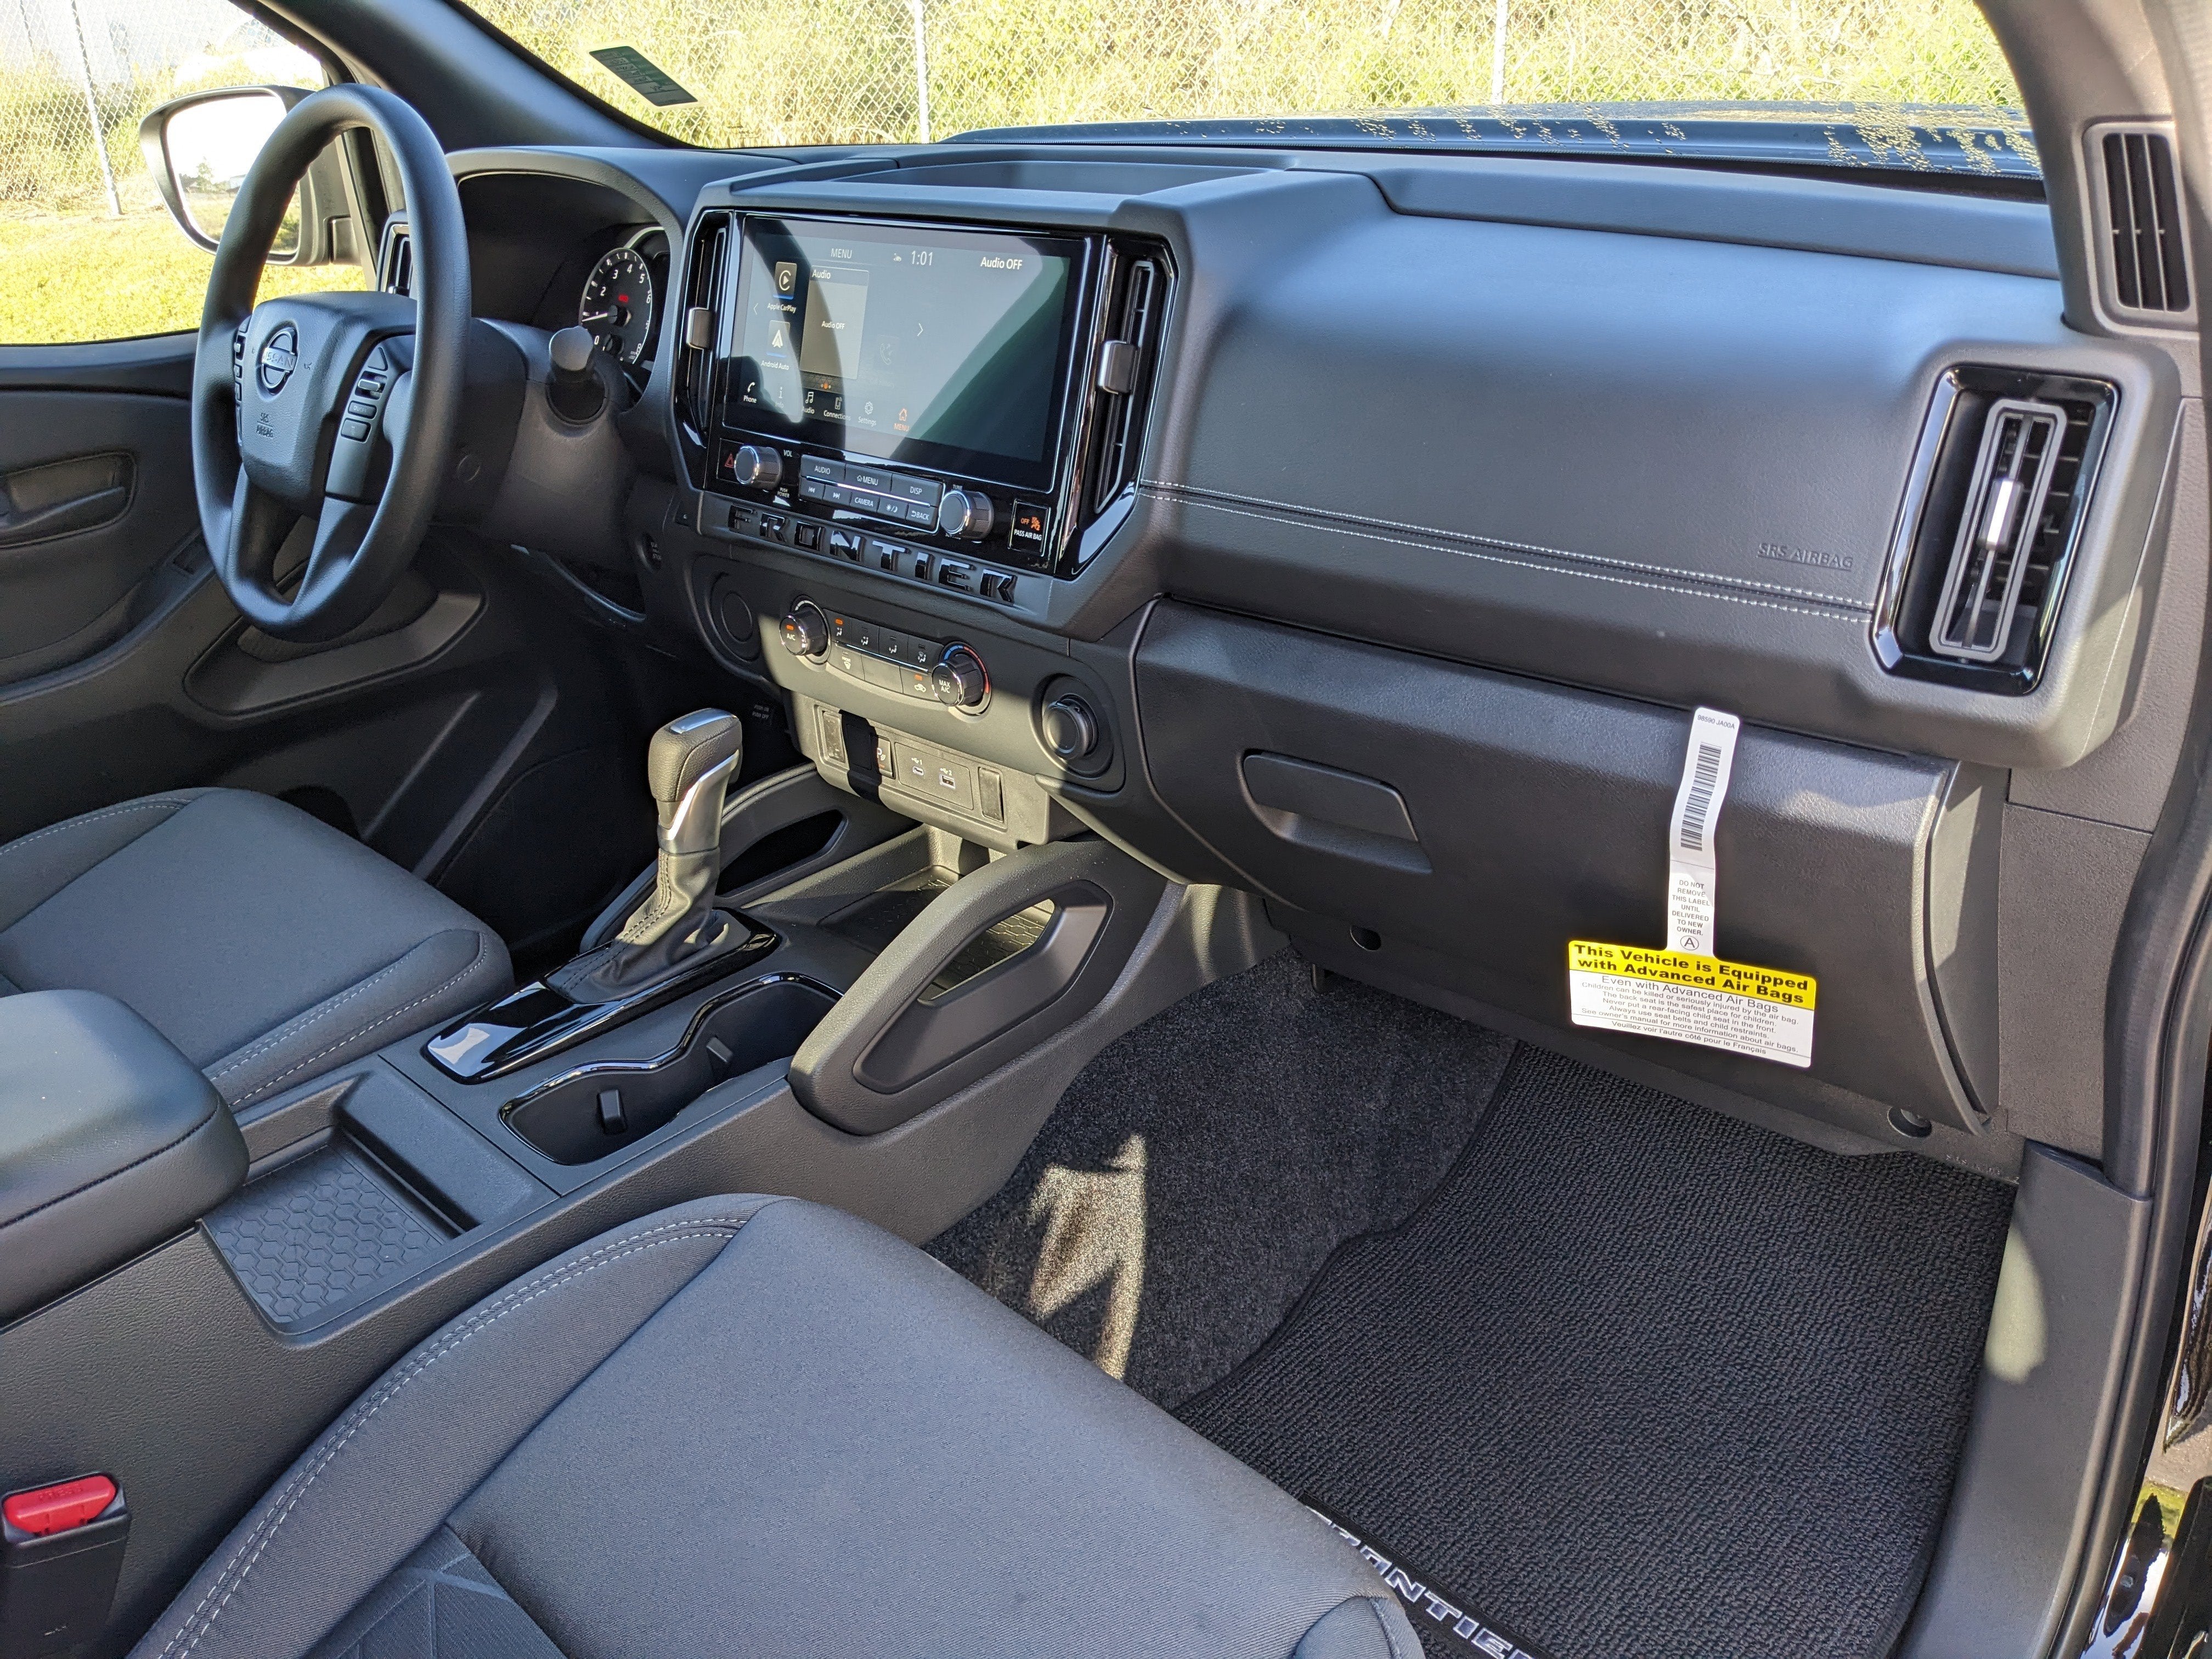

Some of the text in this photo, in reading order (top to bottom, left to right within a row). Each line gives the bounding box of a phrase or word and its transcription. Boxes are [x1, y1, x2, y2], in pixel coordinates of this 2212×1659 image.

[831, 248, 852, 259] MENU
[911, 250, 933, 266] 1:01
[980, 257, 1023, 270] Audio OFF
[612, 269, 619, 279] 3
[627, 264, 633, 274] 4
[812, 269, 831, 279] Audio
[639, 274, 645, 284] 5
[600, 286, 606, 296] 2
[767, 302, 796, 313] Apple CarPlay
[821, 320, 835, 329] Audio
[594, 335, 600, 345] 0
[262, 350, 294, 368] ISSAN
[761, 360, 790, 370] Android Auto
[743, 395, 757, 404] Phone
[802, 405, 815, 414] Audio
[823, 410, 851, 421] Connections
[858, 416, 877, 427] Settings
[894, 422, 910, 432] MENU
[783, 449, 793, 458] VOL
[814, 465, 831, 475] AUDIO
[862, 476, 878, 486] MENU
[910, 486, 923, 495] DISP
[854, 497, 874, 507] CAMERA
[916, 511, 929, 521] BACK
[1014, 529, 1025, 537] PASS
[728, 504, 1018, 604] FRONTIER
[1757, 542, 1853, 569] SRS AIRBAG
[786, 633, 797, 641] A/C
[939, 679, 951, 689] MAX
[940, 685, 951, 695] A/C
[1697, 714, 1735, 730] 98590 JA00A
[1677, 887, 1706, 898] REMOVE
[1672, 894, 1711, 906] THIS LABEL
[1681, 904, 1700, 912] UNTIL
[1672, 910, 1709, 922] DELIVERED
[1677, 926, 1703, 936] OWNER.
[1684, 937, 1696, 948] A
[1574, 944, 1808, 991] This Vehicle is Equipped
[1578, 960, 1804, 1003] with Advanced Air Bags
[1602, 975, 1779, 1013] Even with Advanced Air Bags
[1582, 981, 1614, 991] Children
[1644, 990, 1664, 999] killed
[1676, 996, 1711, 1007] seriously
[1713, 1001, 1740, 1012] injured
[1742, 1006, 1751, 1015] by
[1781, 1014, 1799, 1025] bag.
[1619, 993, 1638, 1001] back
[1639, 996, 1656, 1005] seat
[1681, 1002, 1705, 1013] safest
[1707, 1007, 1729, 1017] place
[1743, 1014, 1778, 1027] children.
[1609, 1005, 1636, 1014] Always
[1673, 1014, 1691, 1023] belts
[1710, 1022, 1729, 1030] child
[1730, 1026, 1770, 1039] restraints.
[1649, 1005, 1690, 1018] rear-facing
[1692, 1012, 1711, 1020] child
[1756, 1024, 1777, 1034] front.
[1599, 1011, 1628, 1019] owner's
[1630, 1014, 1658, 1024] manual
[1660, 1018, 1672, 1026] for
[1673, 1022, 1693, 1030] more
[1694, 1025, 1738, 1039] information
[1740, 1034, 1762, 1044] about
[1776, 1042, 1798, 1053] bags.
[1611, 1020, 1641, 1030] Veuillez
[1659, 1028, 1683, 1037] l'autre
[1733, 1042, 1767, 1054] Français
